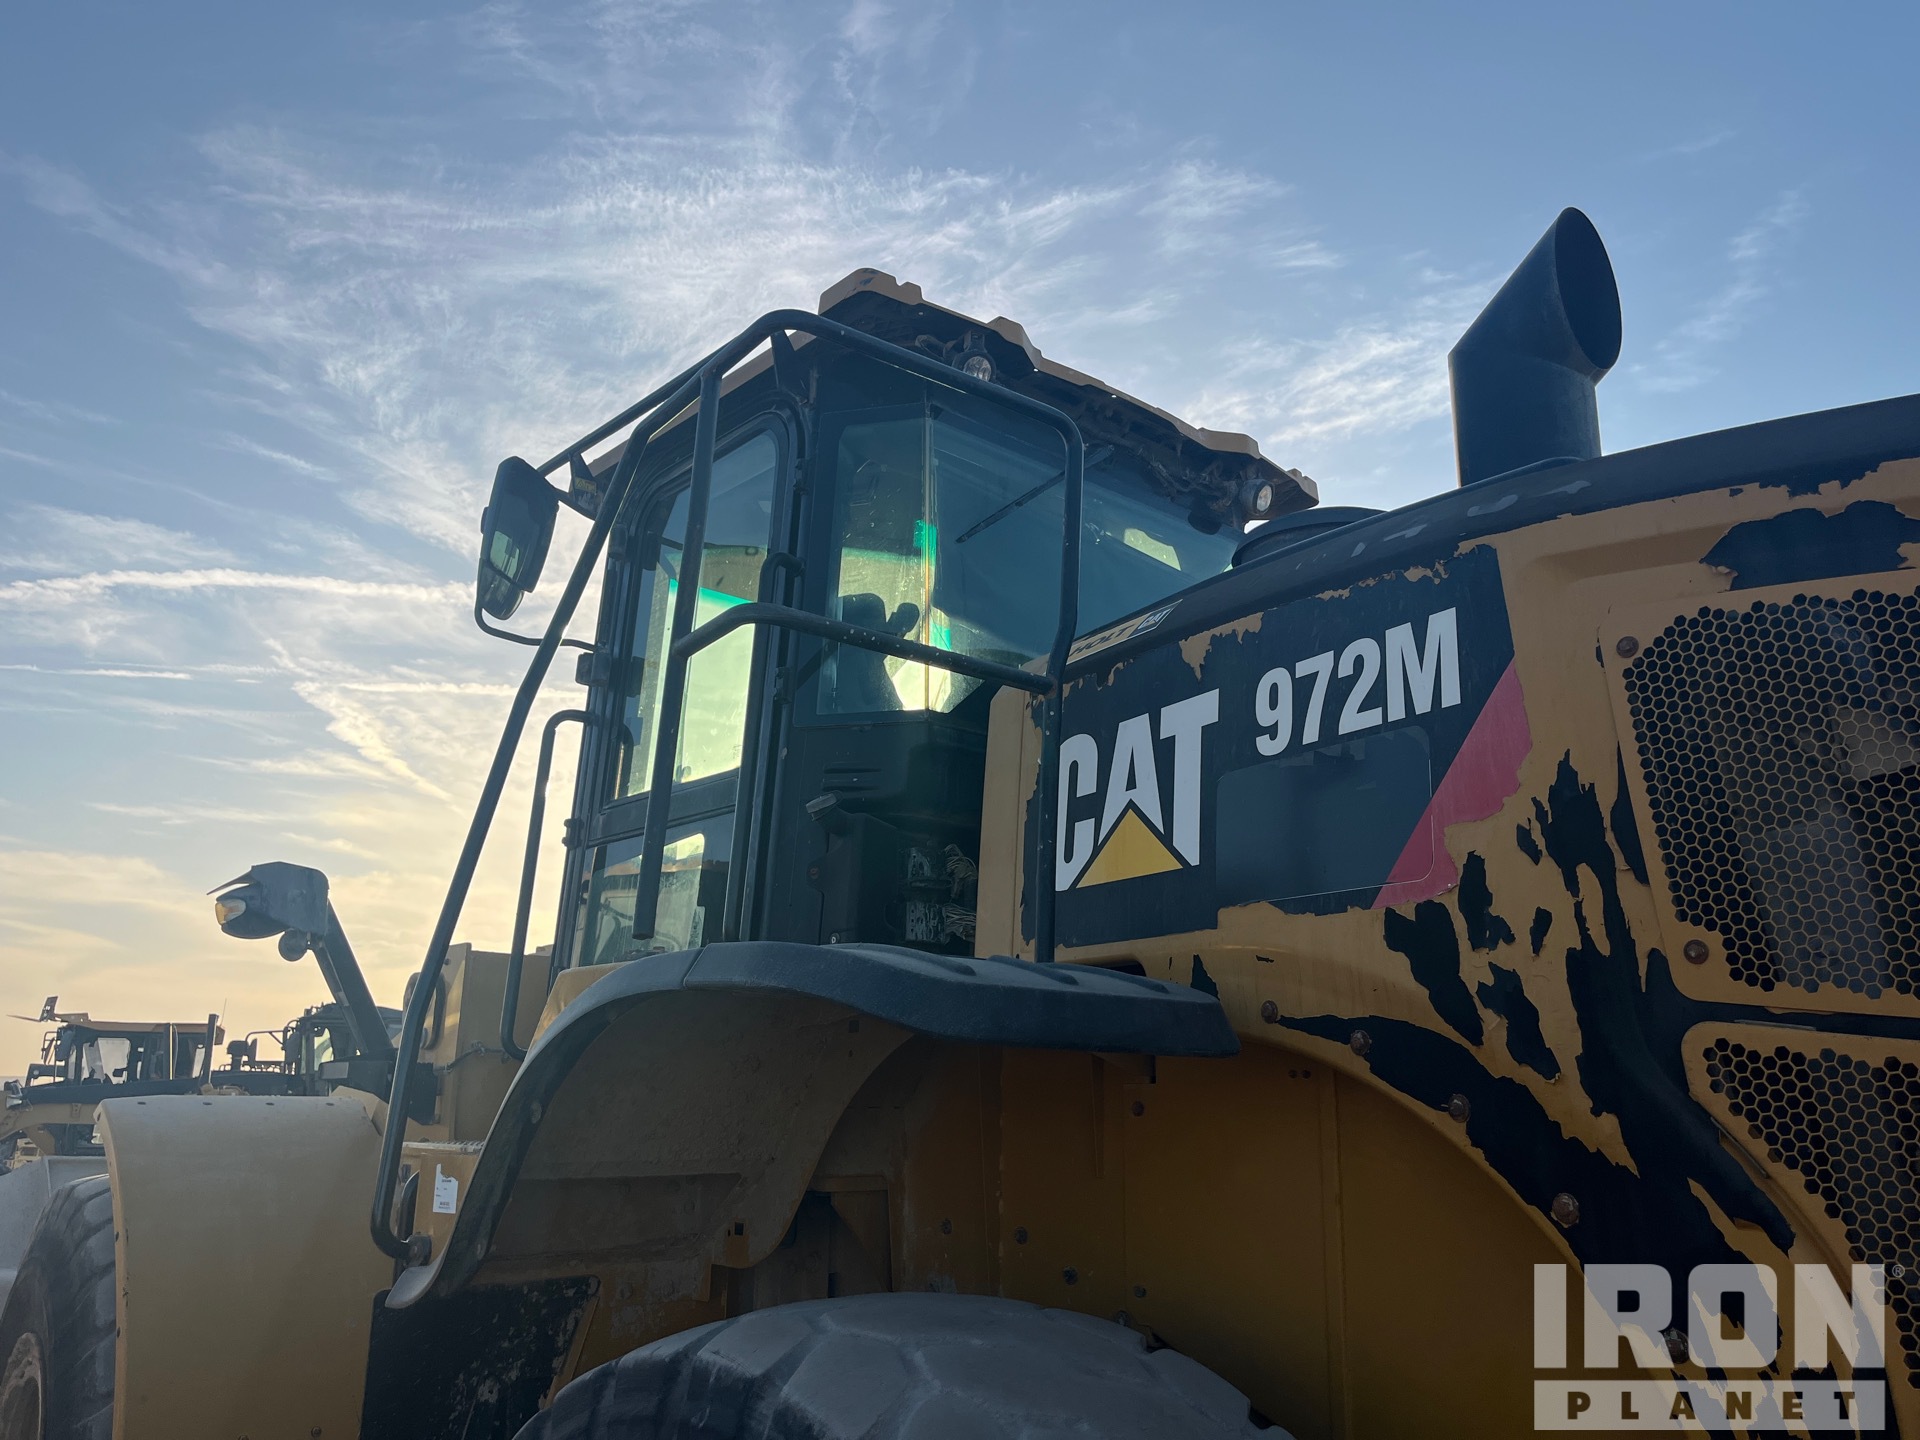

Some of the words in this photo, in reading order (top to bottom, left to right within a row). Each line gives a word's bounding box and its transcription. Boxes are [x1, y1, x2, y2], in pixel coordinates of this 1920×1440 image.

[1069, 624, 1136, 657] HOLT
[1137, 608, 1171, 630] CAT
[1255, 607, 1461, 756] 972M
[1055, 689, 1219, 891] CAT
